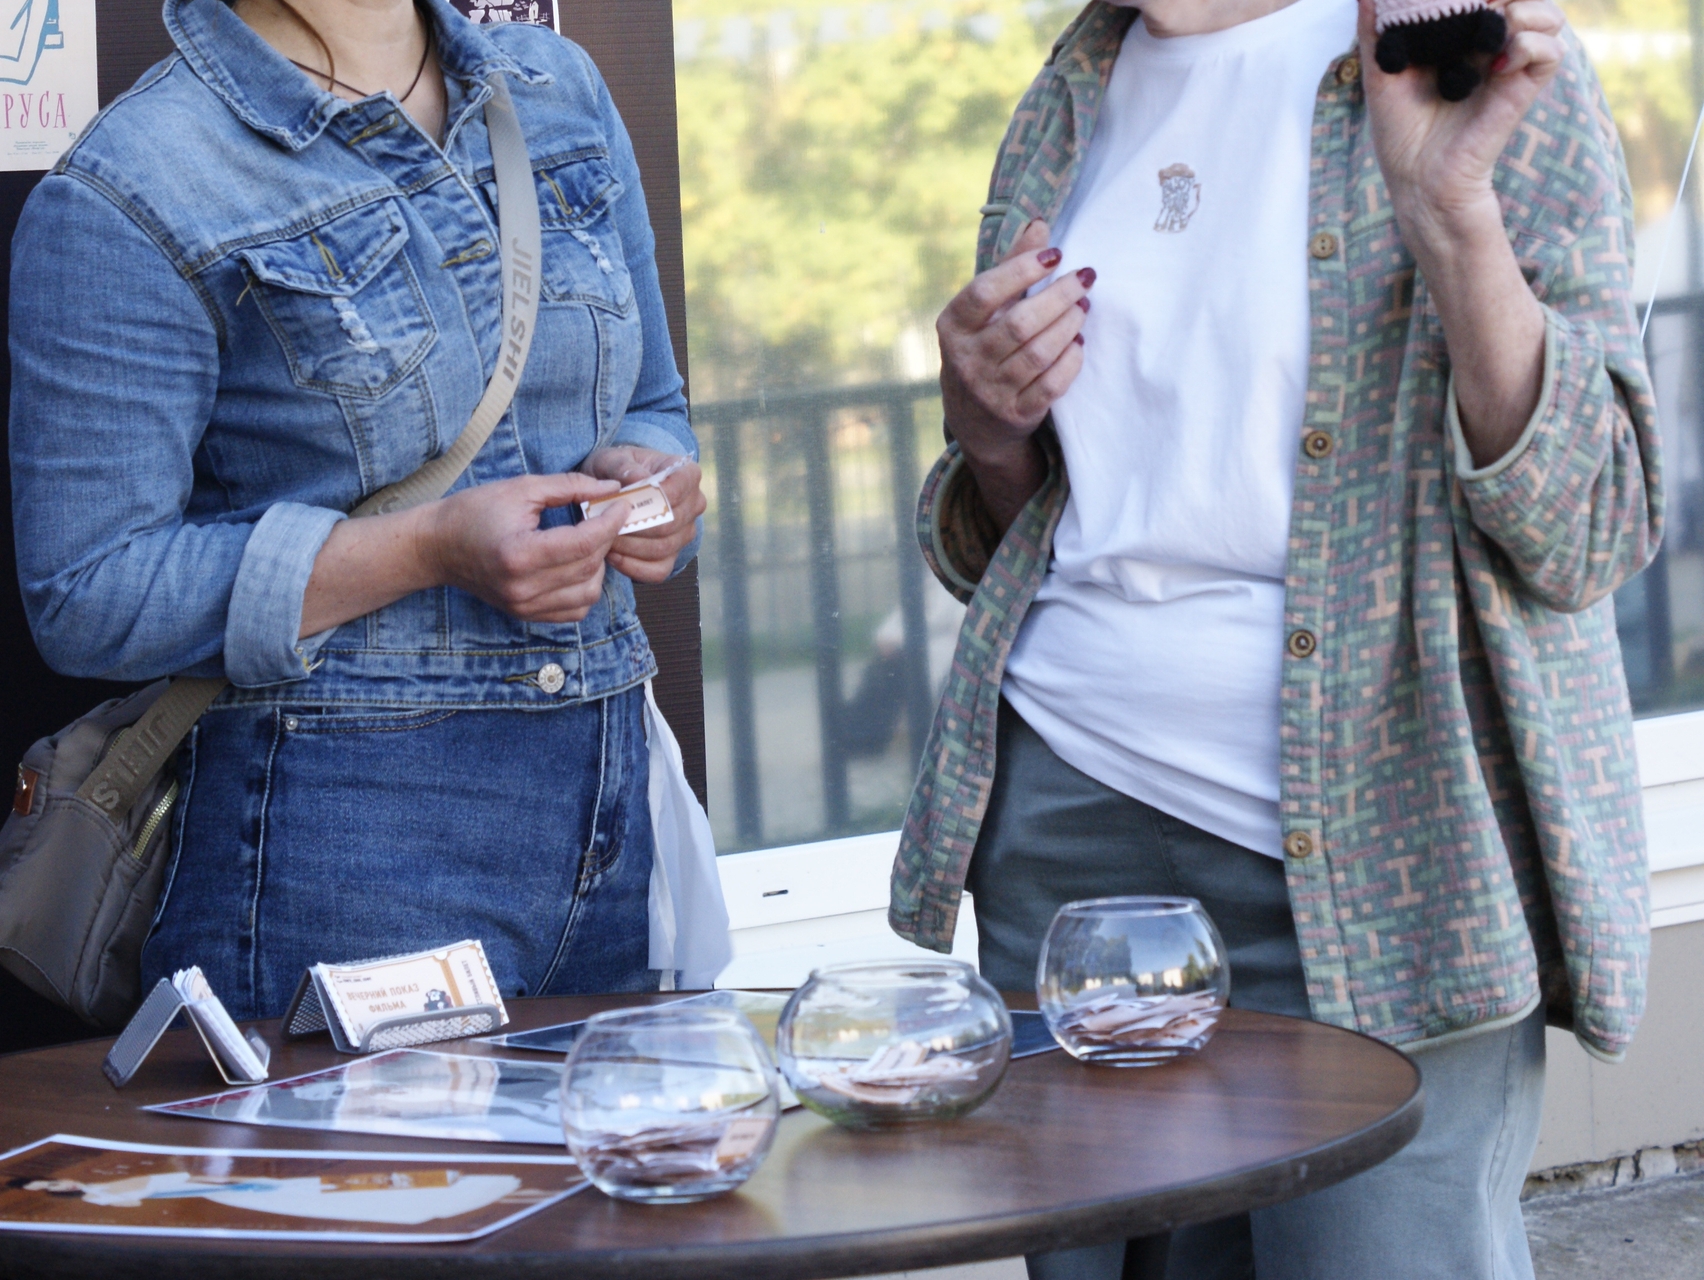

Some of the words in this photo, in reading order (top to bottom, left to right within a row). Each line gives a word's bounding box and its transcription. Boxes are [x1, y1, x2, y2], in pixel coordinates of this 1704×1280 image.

[0, 90, 67, 129] РУСА
[502, 236, 533, 382] JIELSHI
[346, 986, 388, 1001] ВЕЧЕРНИЙ
[390, 983, 420, 996] ПОКАЗ
[368, 1000, 407, 1013] ФИЛЬМА
